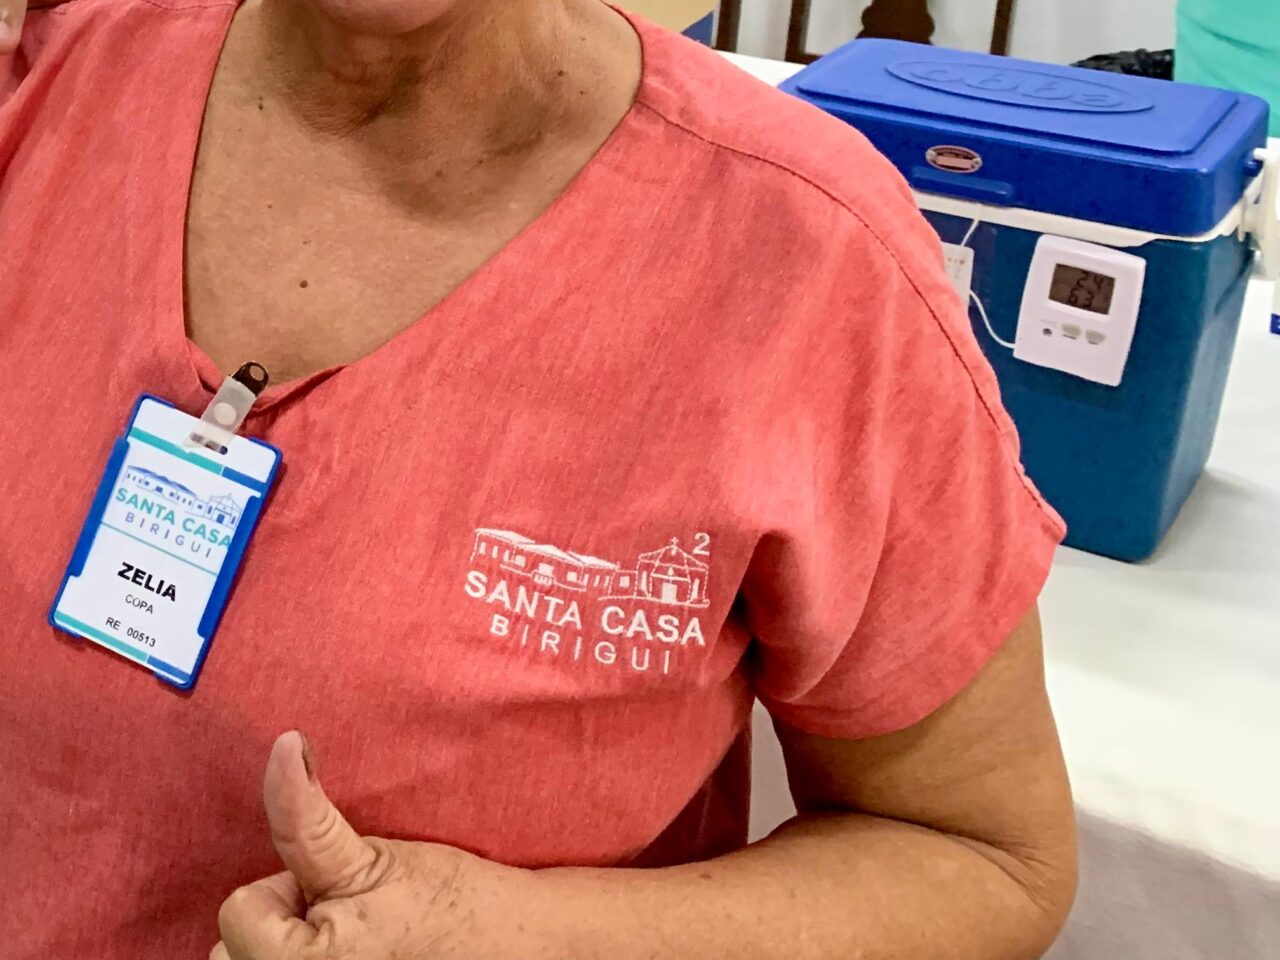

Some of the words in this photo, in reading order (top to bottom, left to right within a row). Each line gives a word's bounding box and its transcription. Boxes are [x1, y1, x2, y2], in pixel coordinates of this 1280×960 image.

[115, 487, 175, 526] SANTA
[182, 518, 233, 548] CASA
[125, 511, 213, 559] BIRIGUI
[693, 532, 710, 556] 2
[117, 561, 177, 602] ZELIA
[125, 593, 154, 615] COPA
[464, 570, 583, 630] SANTA
[601, 605, 706, 647] CASA
[105, 617, 121, 632] RE
[126, 626, 157, 649] 00513
[490, 613, 671, 674] BIRIGUI
